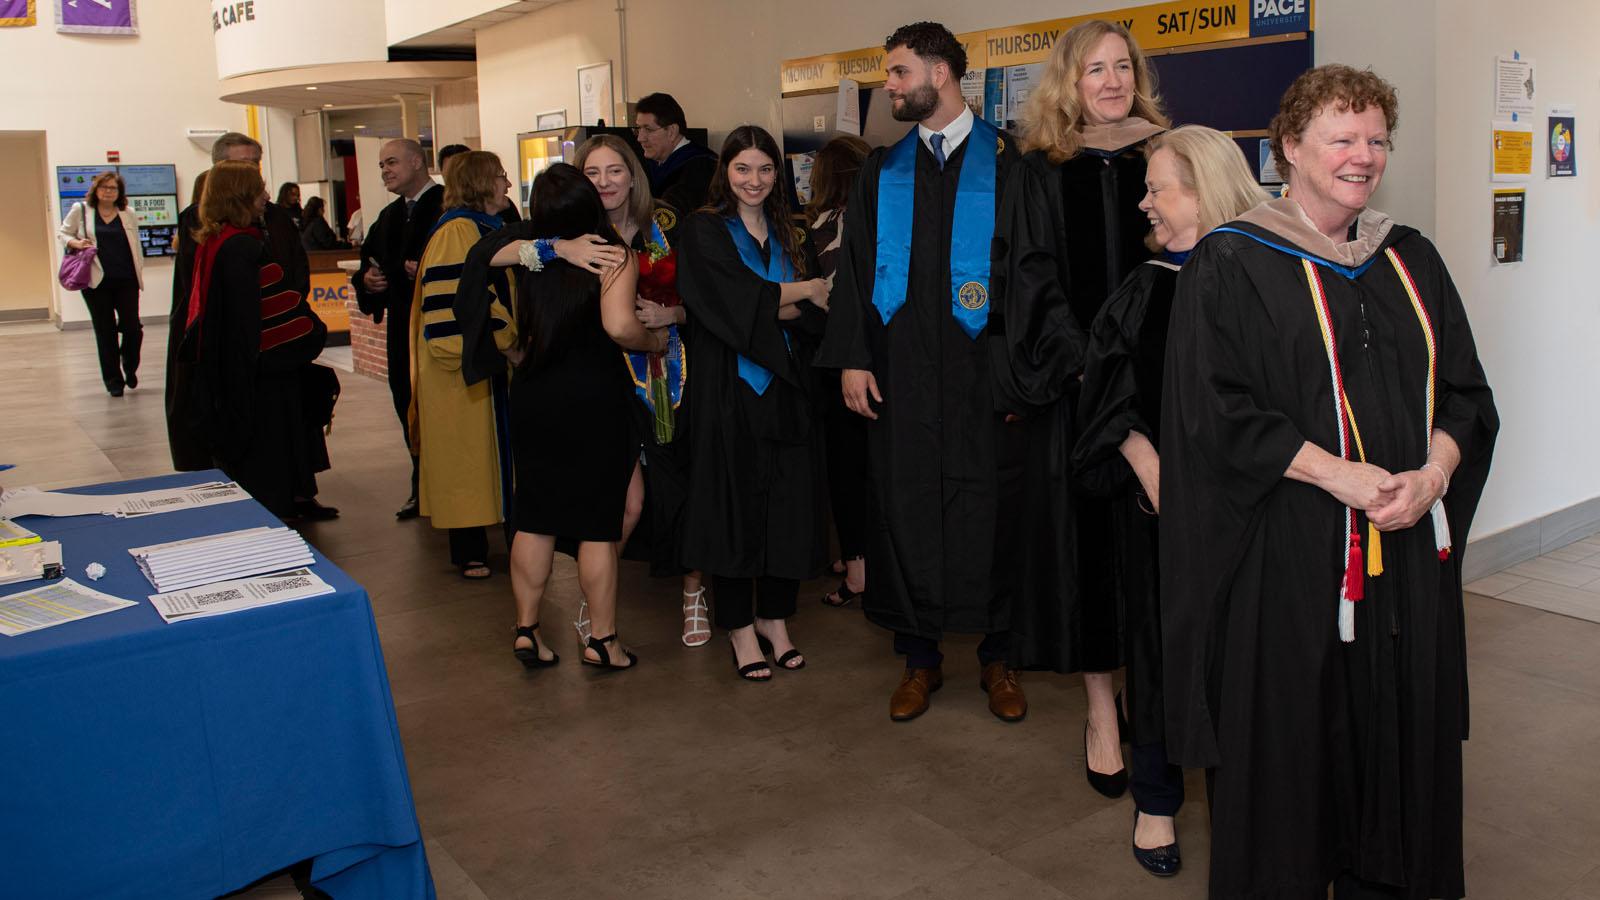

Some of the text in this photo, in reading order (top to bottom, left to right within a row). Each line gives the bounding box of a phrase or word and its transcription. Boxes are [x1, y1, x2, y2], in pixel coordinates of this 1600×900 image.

[222, 0, 255, 26] CAFE
[1253, 0, 1305, 18] PACE
[1256, 15, 1302, 26] UNIVERSITY
[784, 64, 824, 83] MONDAY
[838, 54, 883, 76] TUESDAY
[987, 30, 1059, 57] THURSDAY
[1157, 5, 1236, 35] SAT/SUN
[313, 286, 348, 301] PAC
